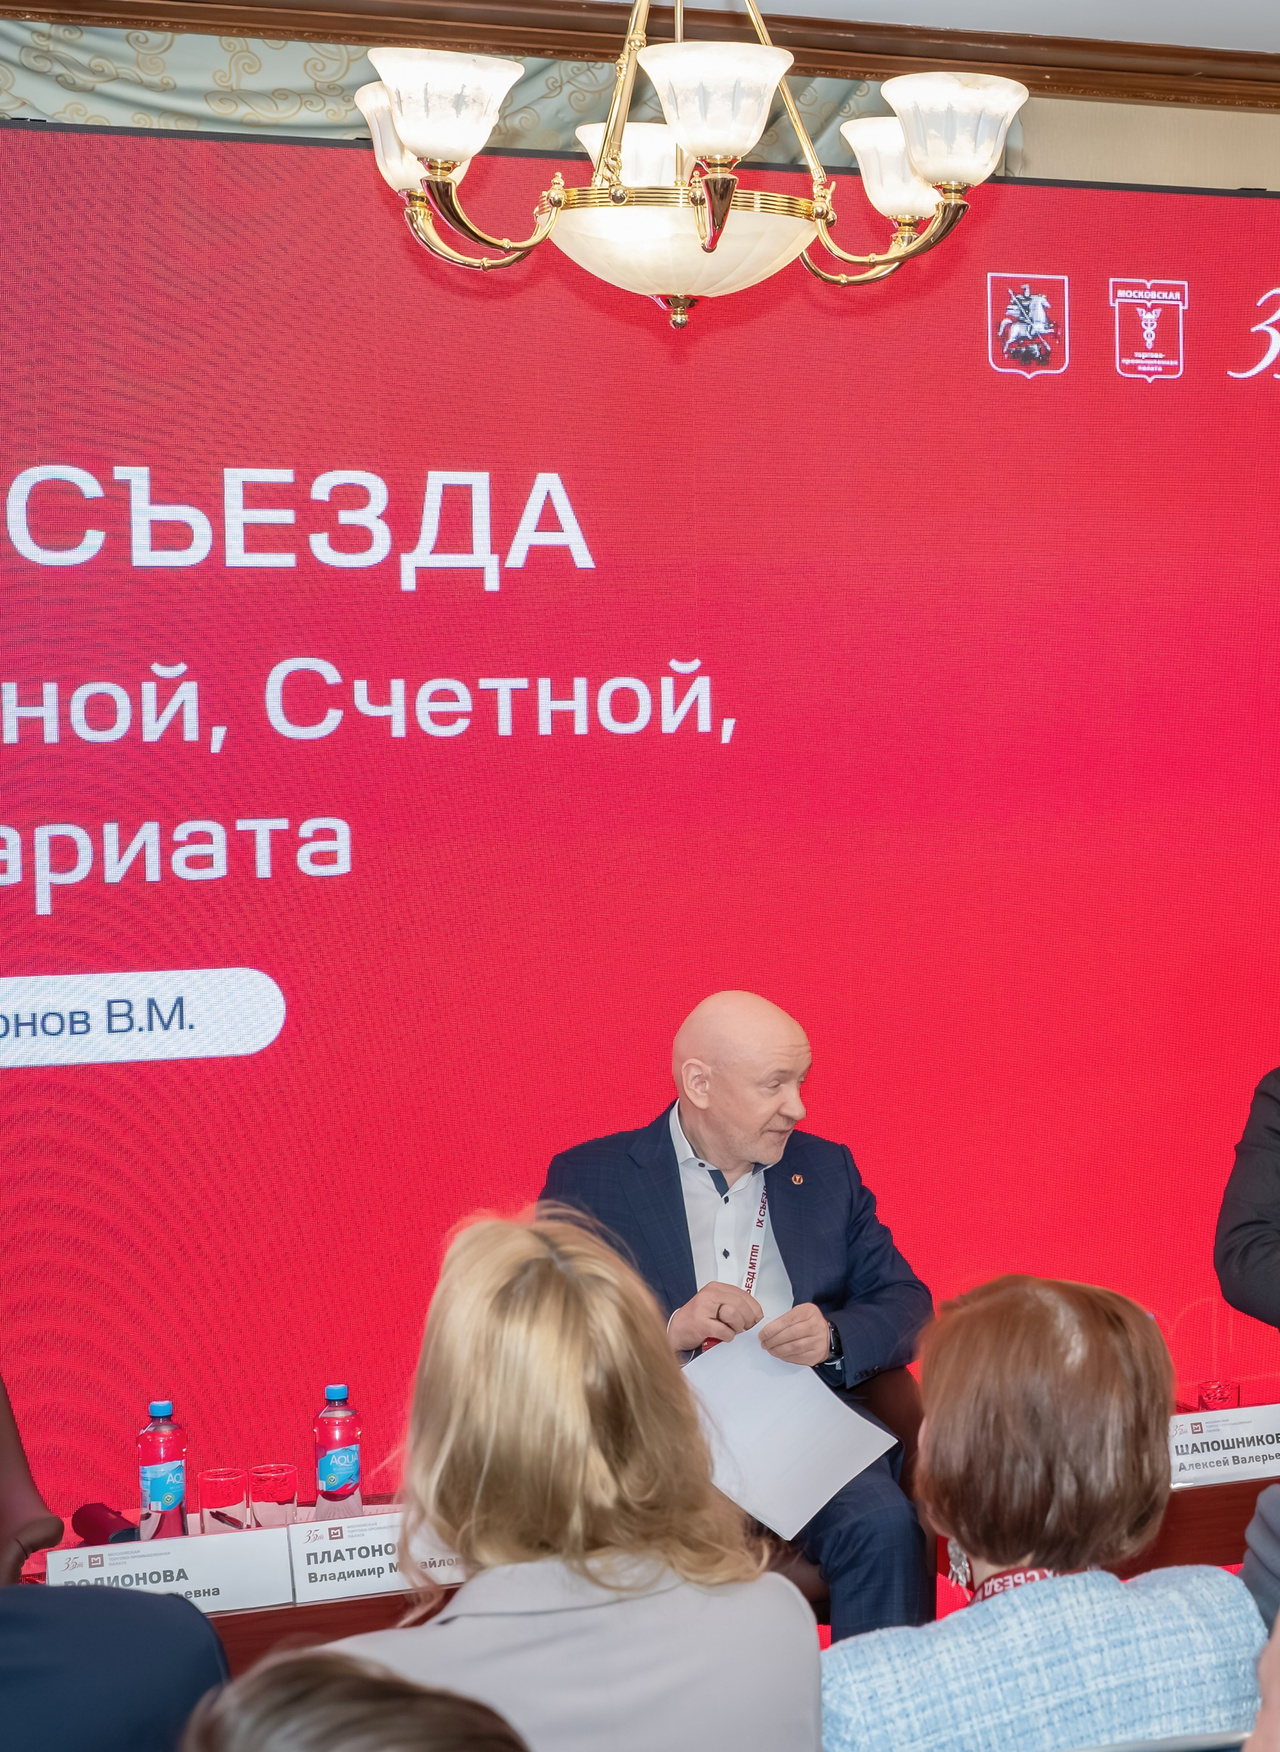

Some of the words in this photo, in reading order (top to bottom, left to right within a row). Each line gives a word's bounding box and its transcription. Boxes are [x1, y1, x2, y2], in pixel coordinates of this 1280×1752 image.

[1117, 289, 1181, 300] МОСКОВСКАЯ
[5, 464, 597, 592] СЪЕЗДА
[264, 656, 738, 745] Счетной,
[106, 995, 195, 1034] В.М.
[748, 1244, 760, 1271] МТПП
[1178, 1456, 1230, 1473] Алексей
[306, 1542, 400, 1566] ПЛАТОНО
[307, 1565, 385, 1584] Владимир
